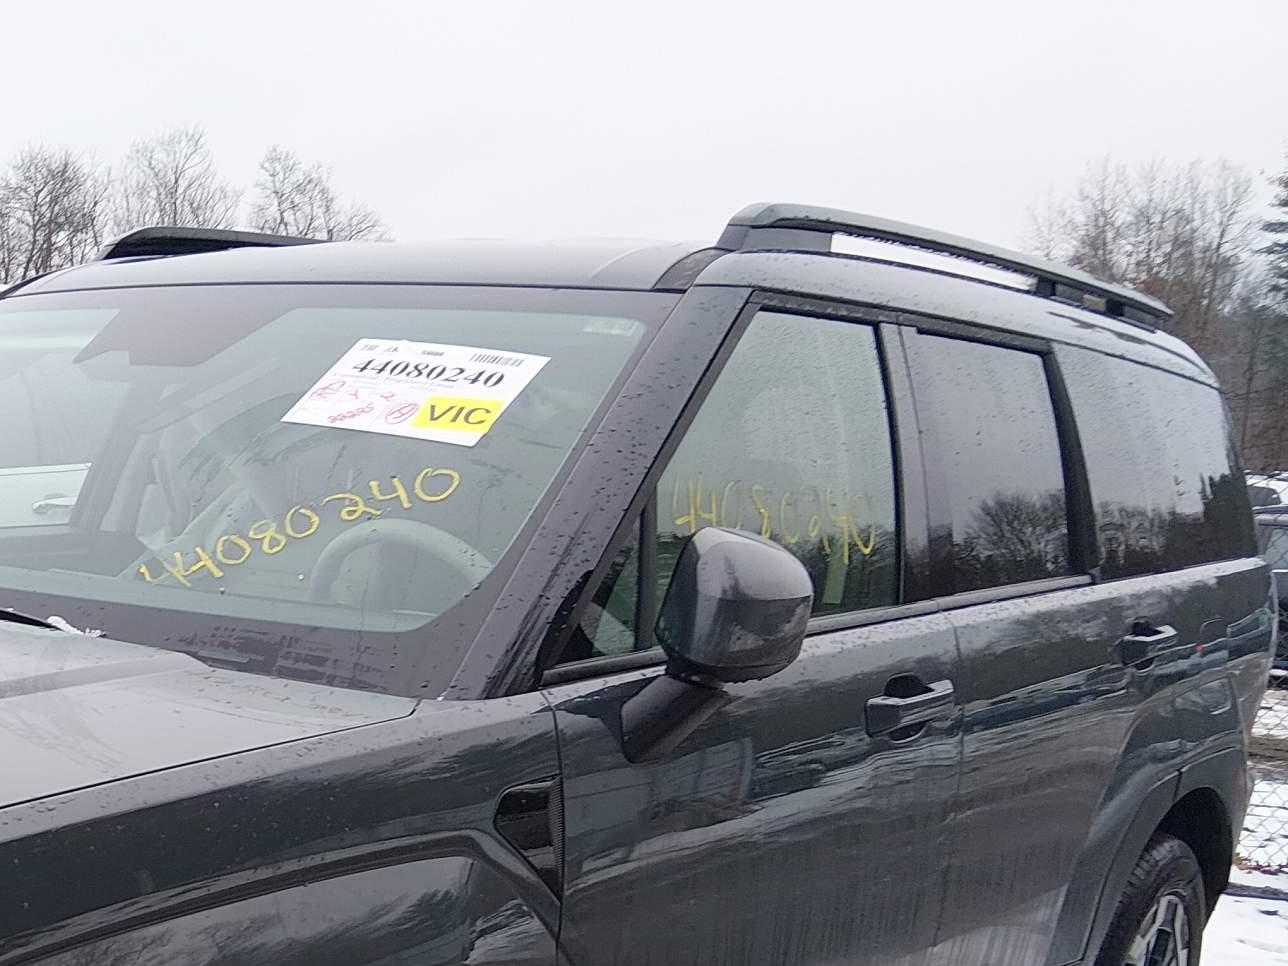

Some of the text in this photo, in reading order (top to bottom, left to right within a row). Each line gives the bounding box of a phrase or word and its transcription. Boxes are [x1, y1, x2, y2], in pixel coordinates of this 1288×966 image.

[352, 357, 505, 388] 44080240
[429, 405, 491, 425] VIC
[137, 467, 460, 587] 44080240
